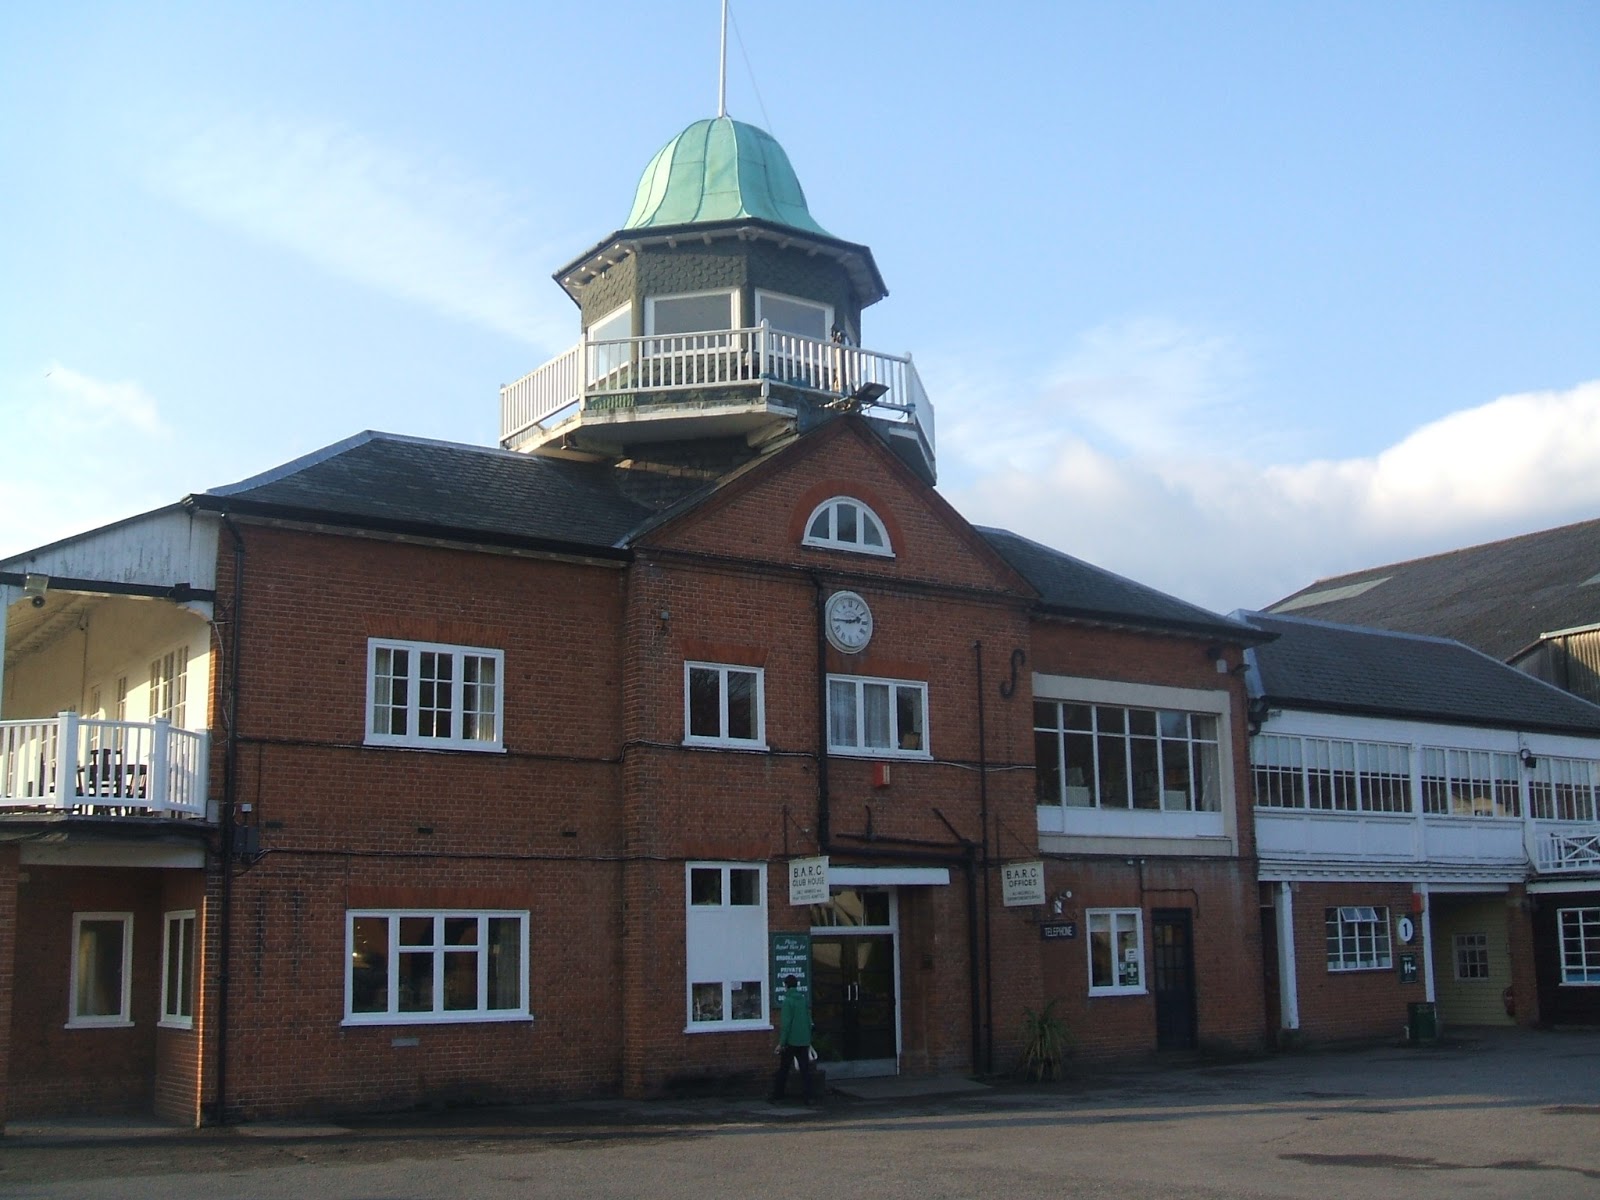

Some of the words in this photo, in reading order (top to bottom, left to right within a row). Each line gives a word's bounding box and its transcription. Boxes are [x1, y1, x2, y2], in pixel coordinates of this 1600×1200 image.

[792, 879, 806, 887] CLUB
[807, 877, 825, 886] HOUSE
[1009, 879, 1037, 888] OFFICES
[1044, 926, 1073, 937] TELEPHONE
[1403, 922, 1408, 937] 1
